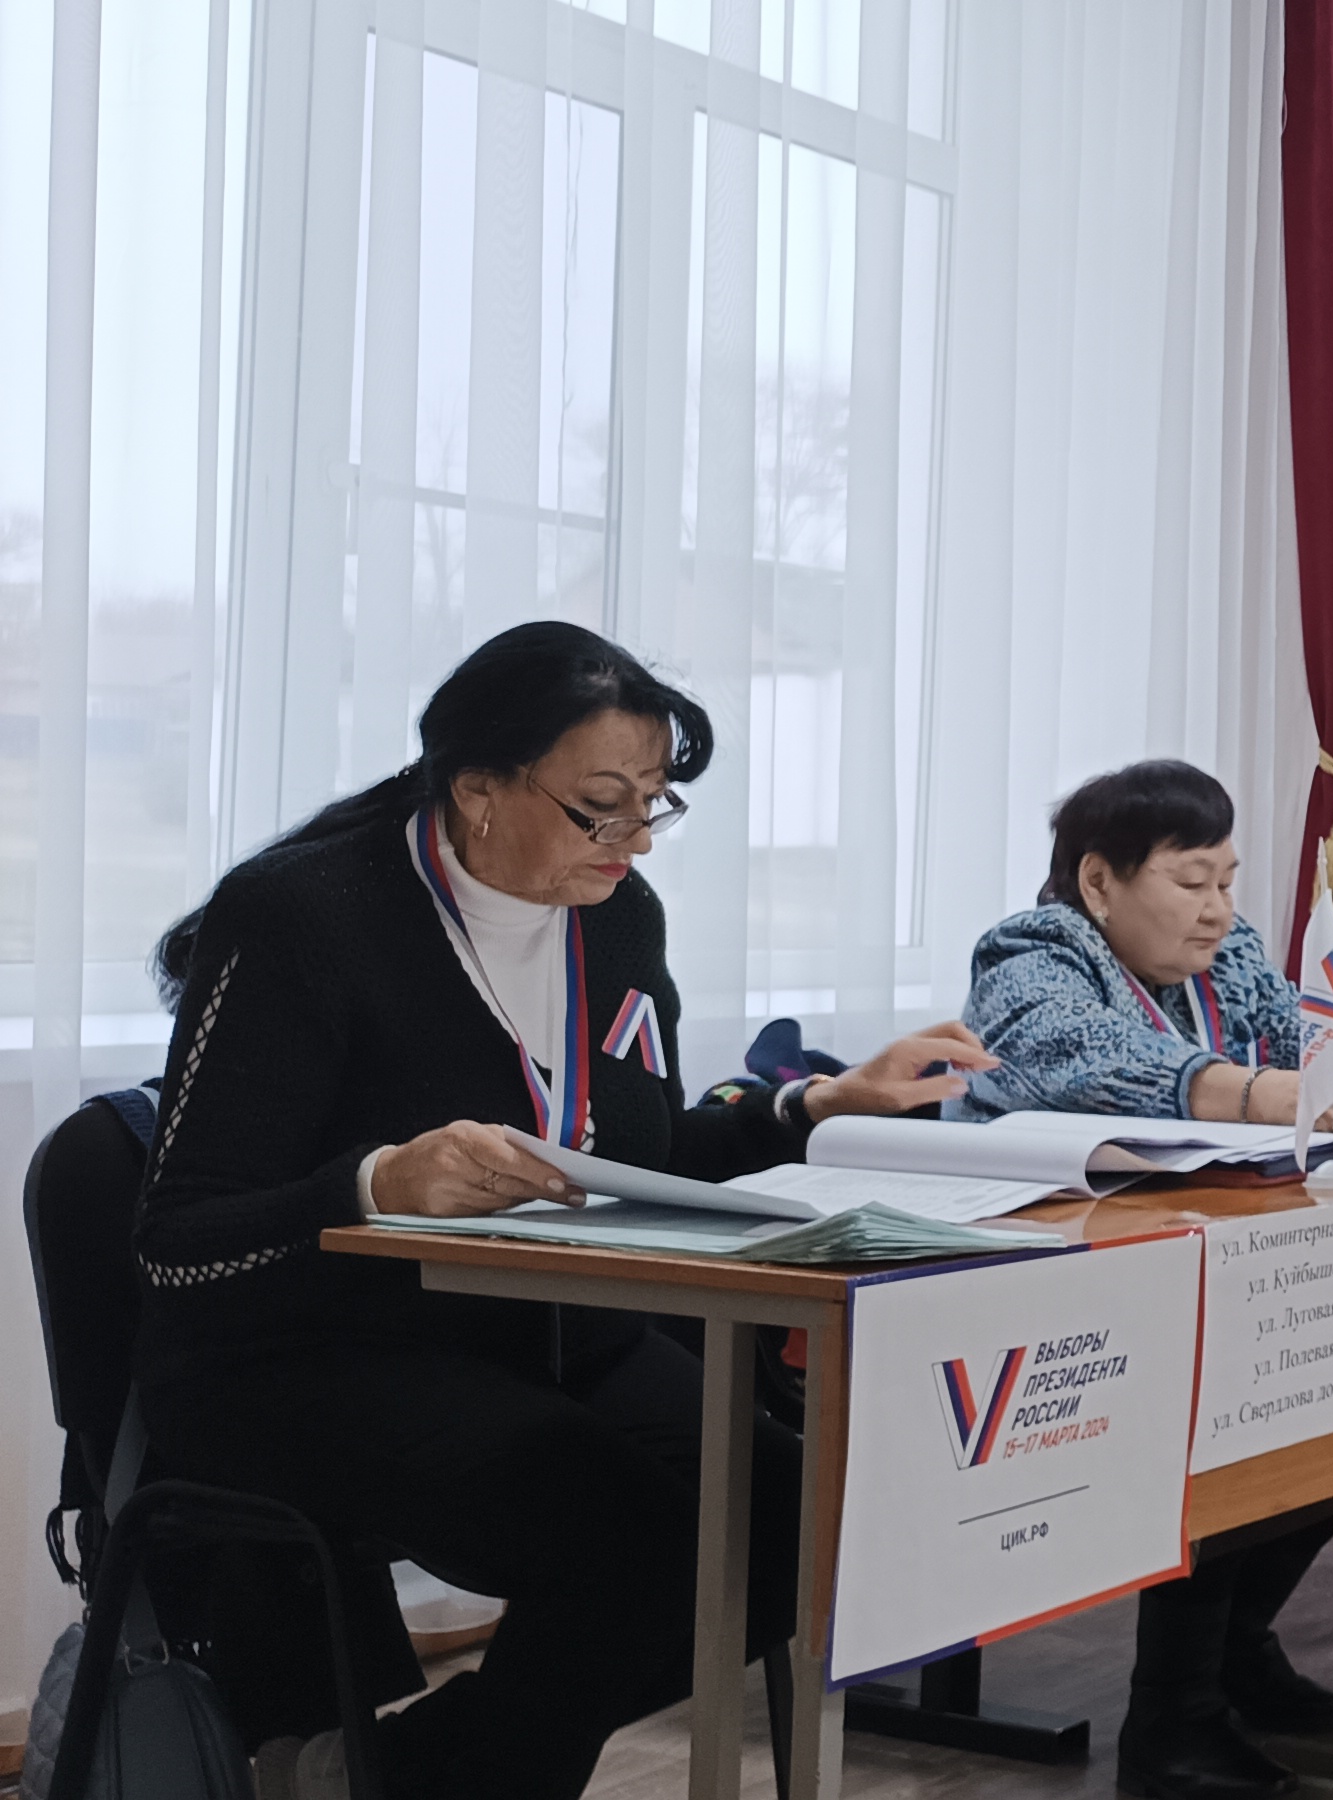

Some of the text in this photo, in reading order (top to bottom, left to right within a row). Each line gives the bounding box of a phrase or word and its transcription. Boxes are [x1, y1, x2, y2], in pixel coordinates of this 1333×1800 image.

[1222, 1240, 1244, 1264] ул.
[1247, 1278, 1269, 1301] ул.
[1256, 1318, 1277, 1342] ул.
[1034, 1329, 1110, 1365] ВЫБОРЫ
[1023, 1354, 1128, 1398] ПРЕЗИДЕНТА
[1253, 1361, 1275, 1385] ул.
[1011, 1394, 1082, 1431] РОССИИ
[1211, 1414, 1234, 1438] ул.
[1239, 1386, 1314, 1424] Свердлова
[1316, 1382, 1333, 1402] до
[1003, 1415, 1110, 1459] 15–17 МАРТА 2024
[1001, 1521, 1049, 1552] ЦИК.РФ
